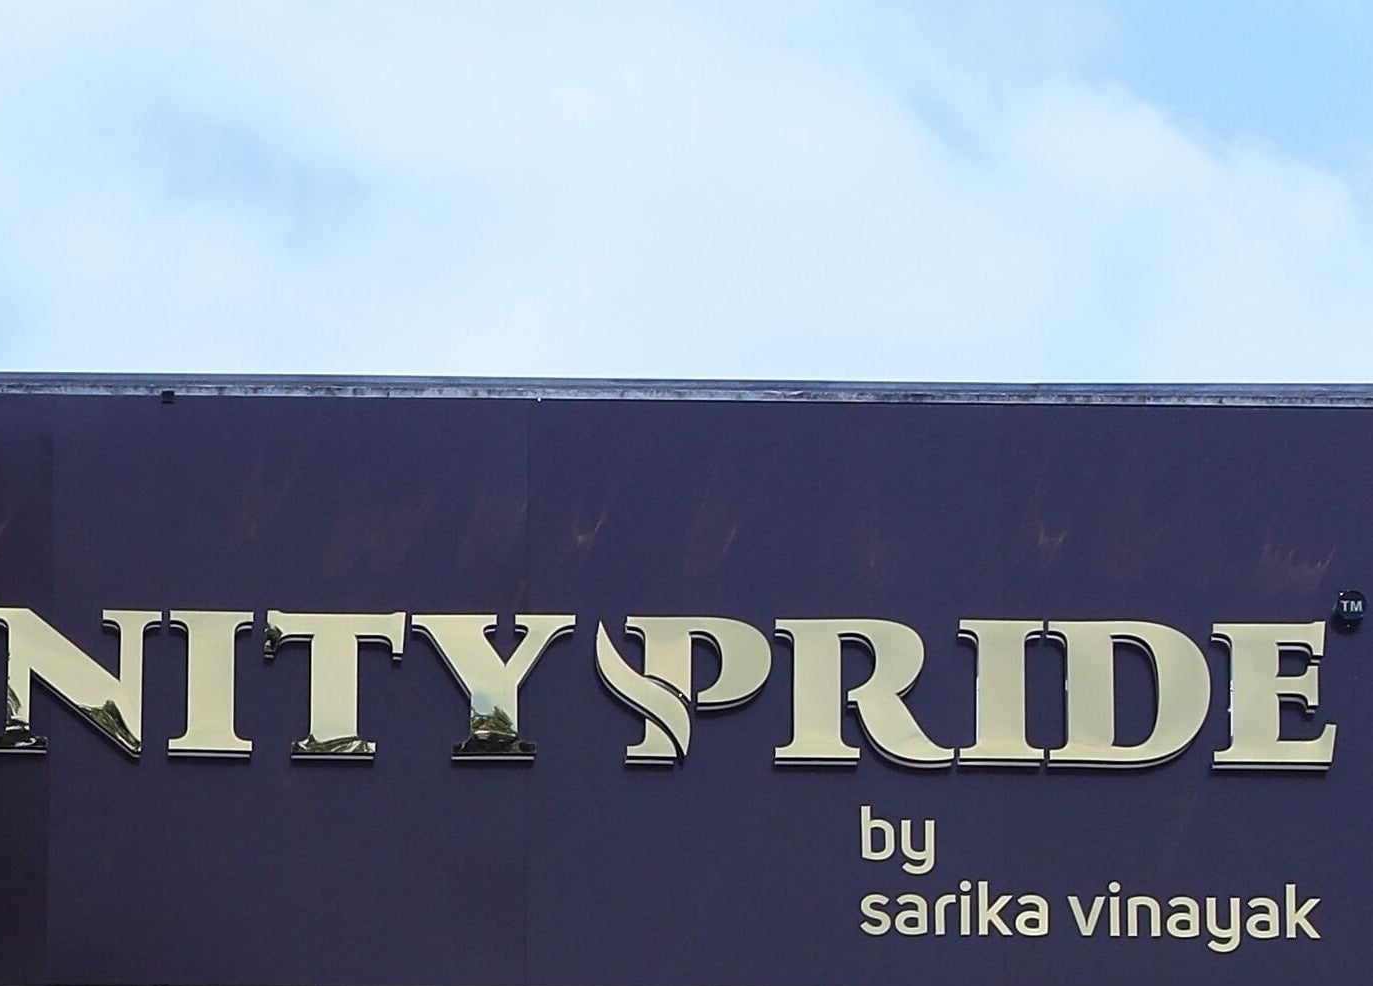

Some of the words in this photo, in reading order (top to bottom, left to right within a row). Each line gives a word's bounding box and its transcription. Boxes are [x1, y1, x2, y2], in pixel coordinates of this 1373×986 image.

[1340, 600, 1364, 612] TM
[860, 805, 936, 875] by
[860, 880, 1049, 937] sarika
[1067, 881, 1321, 953] vinayak
